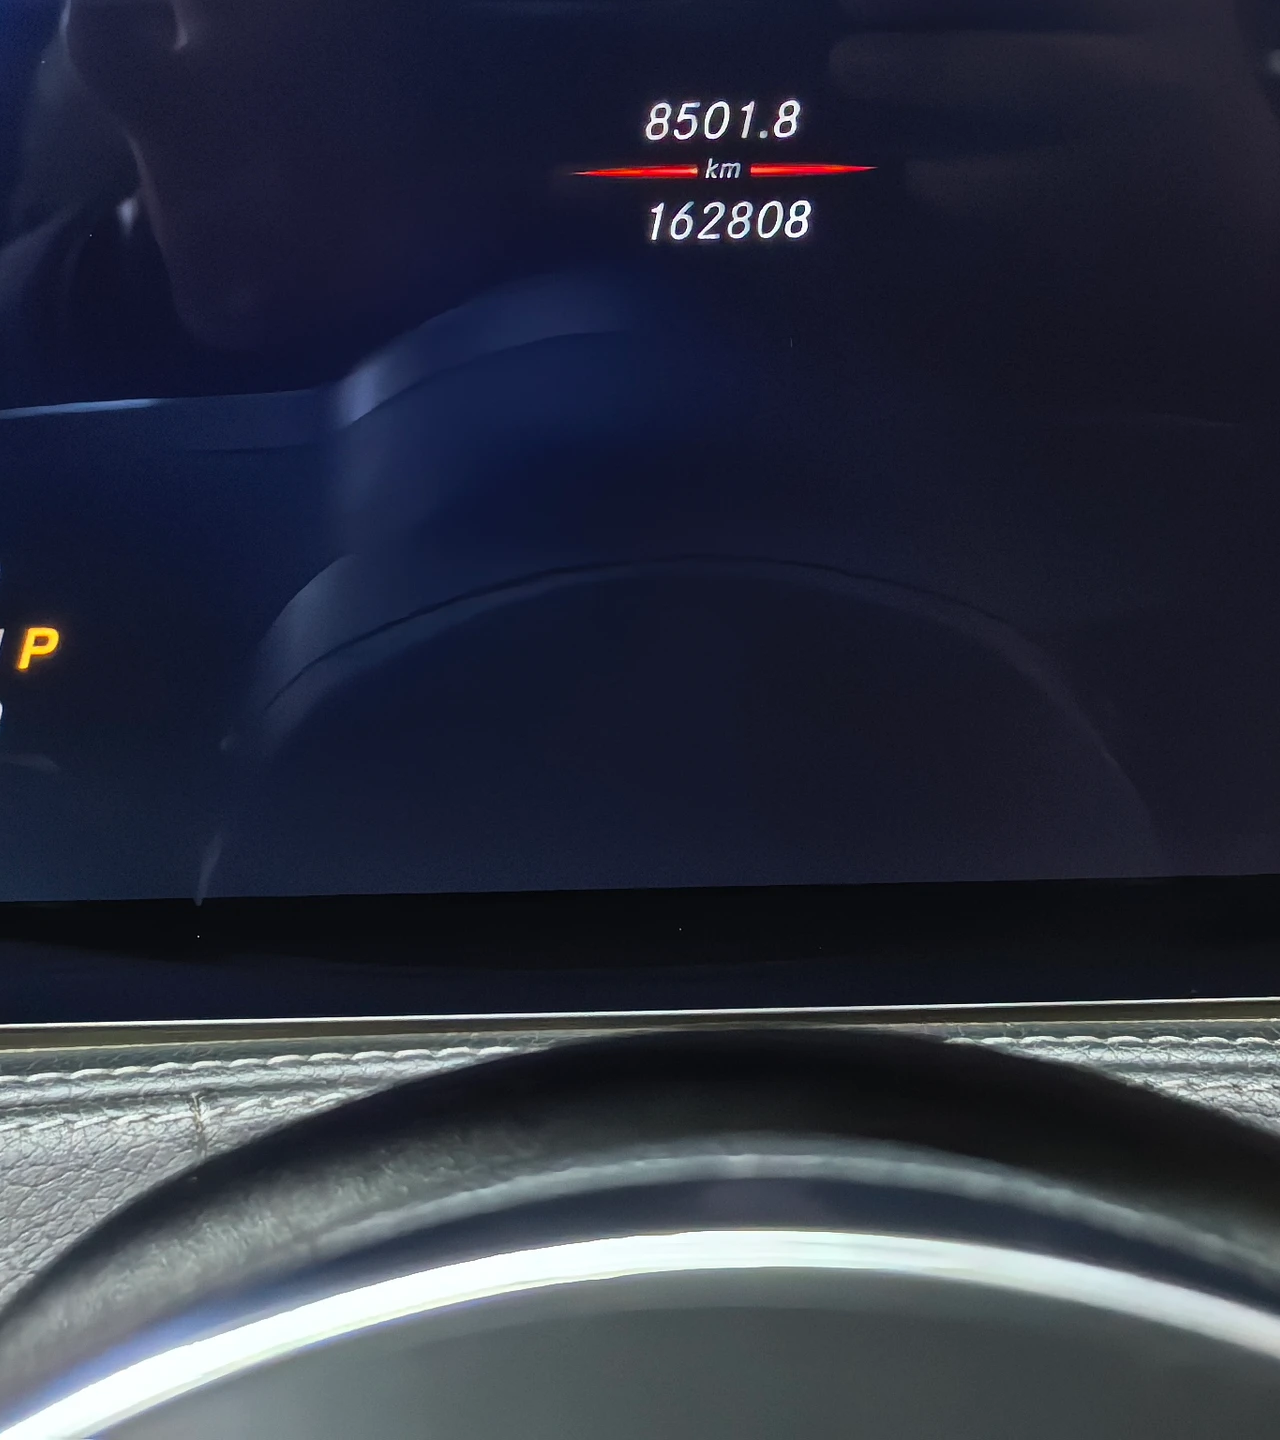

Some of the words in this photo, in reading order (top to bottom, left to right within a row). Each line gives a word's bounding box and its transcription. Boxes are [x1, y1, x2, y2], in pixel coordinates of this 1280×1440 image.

[645, 100, 801, 141] 8501.8
[705, 158, 741, 179] km
[649, 199, 812, 241] 162808
[17, 627, 60, 670] P
